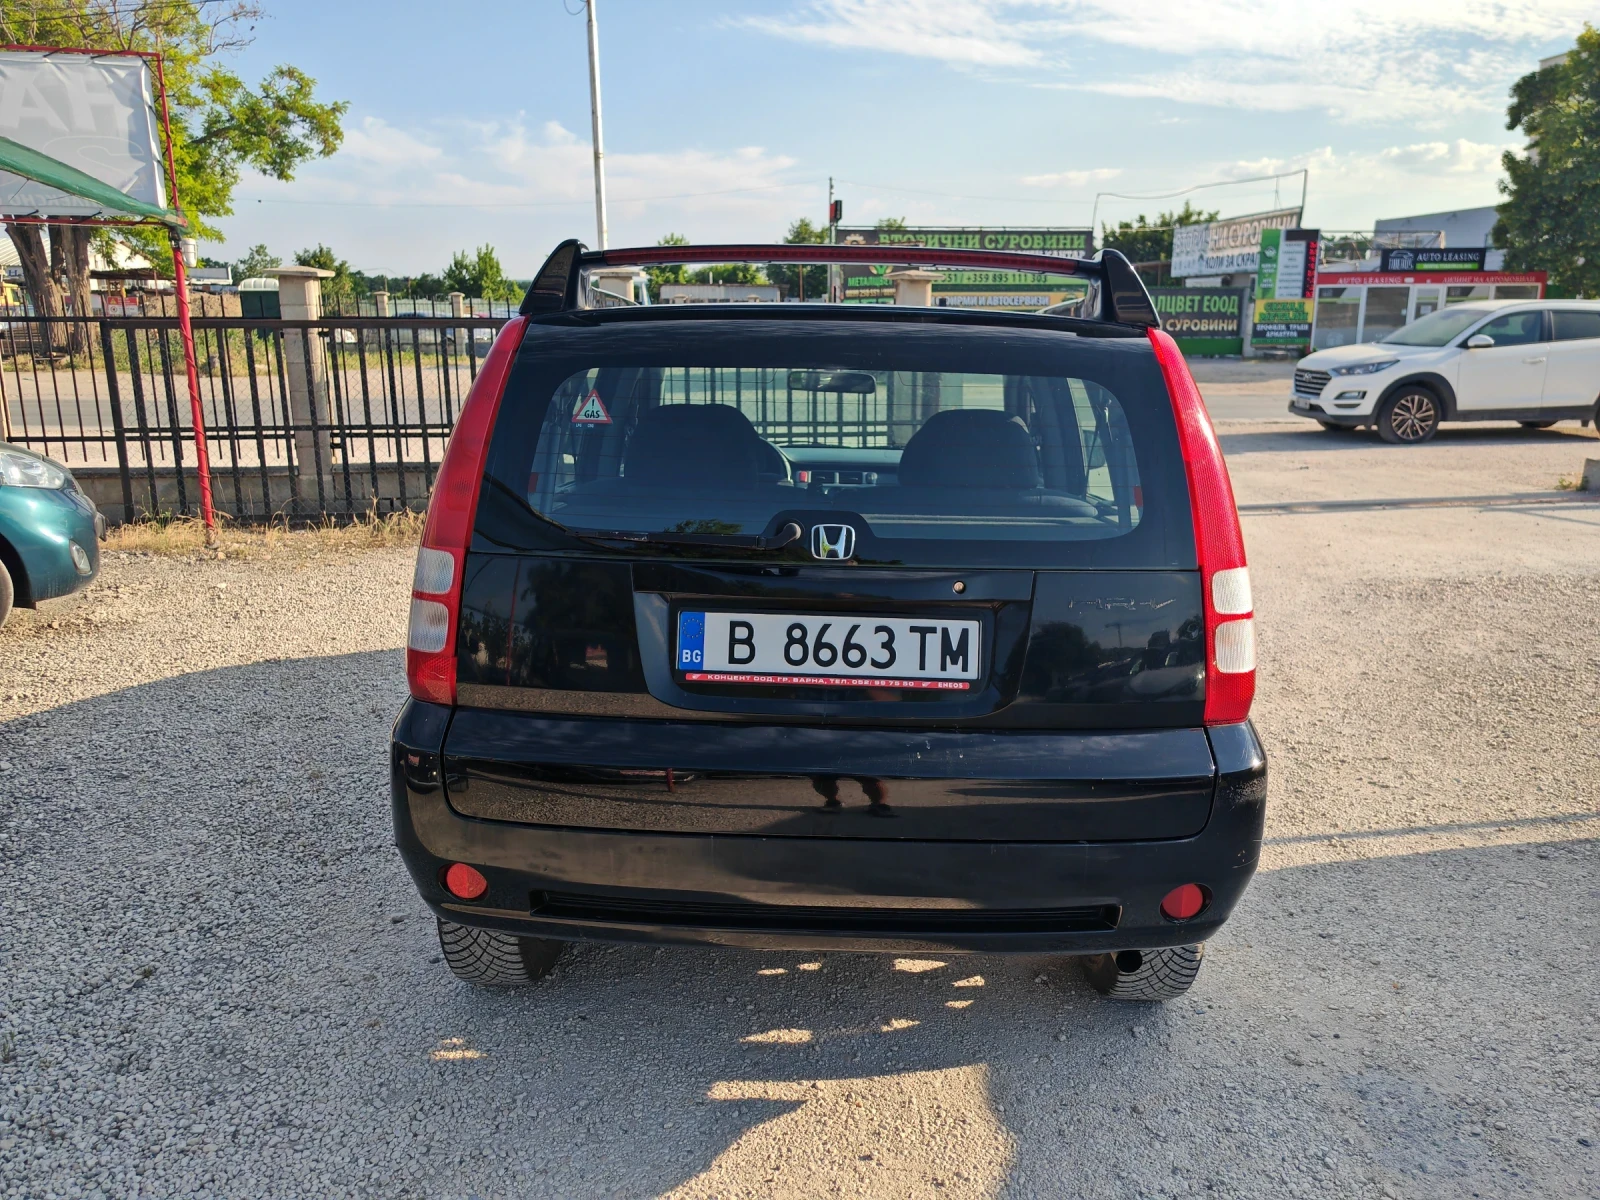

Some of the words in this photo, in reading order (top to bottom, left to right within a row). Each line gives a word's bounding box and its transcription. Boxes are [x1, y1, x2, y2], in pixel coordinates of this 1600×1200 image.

[984, 234, 1086, 249] СУРОВИНИ
[1417, 252, 1441, 262] AUTO
[1443, 252, 1480, 262] LEASING
[967, 275, 989, 283] +359
[992, 274, 1008, 283] 895
[1012, 274, 1027, 284] 111
[1031, 275, 1047, 284] 303
[1364, 276, 1401, 284] LEASING
[979, 297, 986, 306] И
[987, 297, 1049, 307] АВТОСЕРВИЗИ
[1203, 295, 1239, 316] ЕООД
[1166, 319, 1238, 332] СУРОВИНИ
[584, 410, 600, 419] GAS
[727, 620, 756, 664] B
[784, 622, 897, 670] 8663
[909, 624, 970, 672] TM
[682, 649, 702, 663] BG
[707, 674, 751, 682] КОНЦЕНТ
